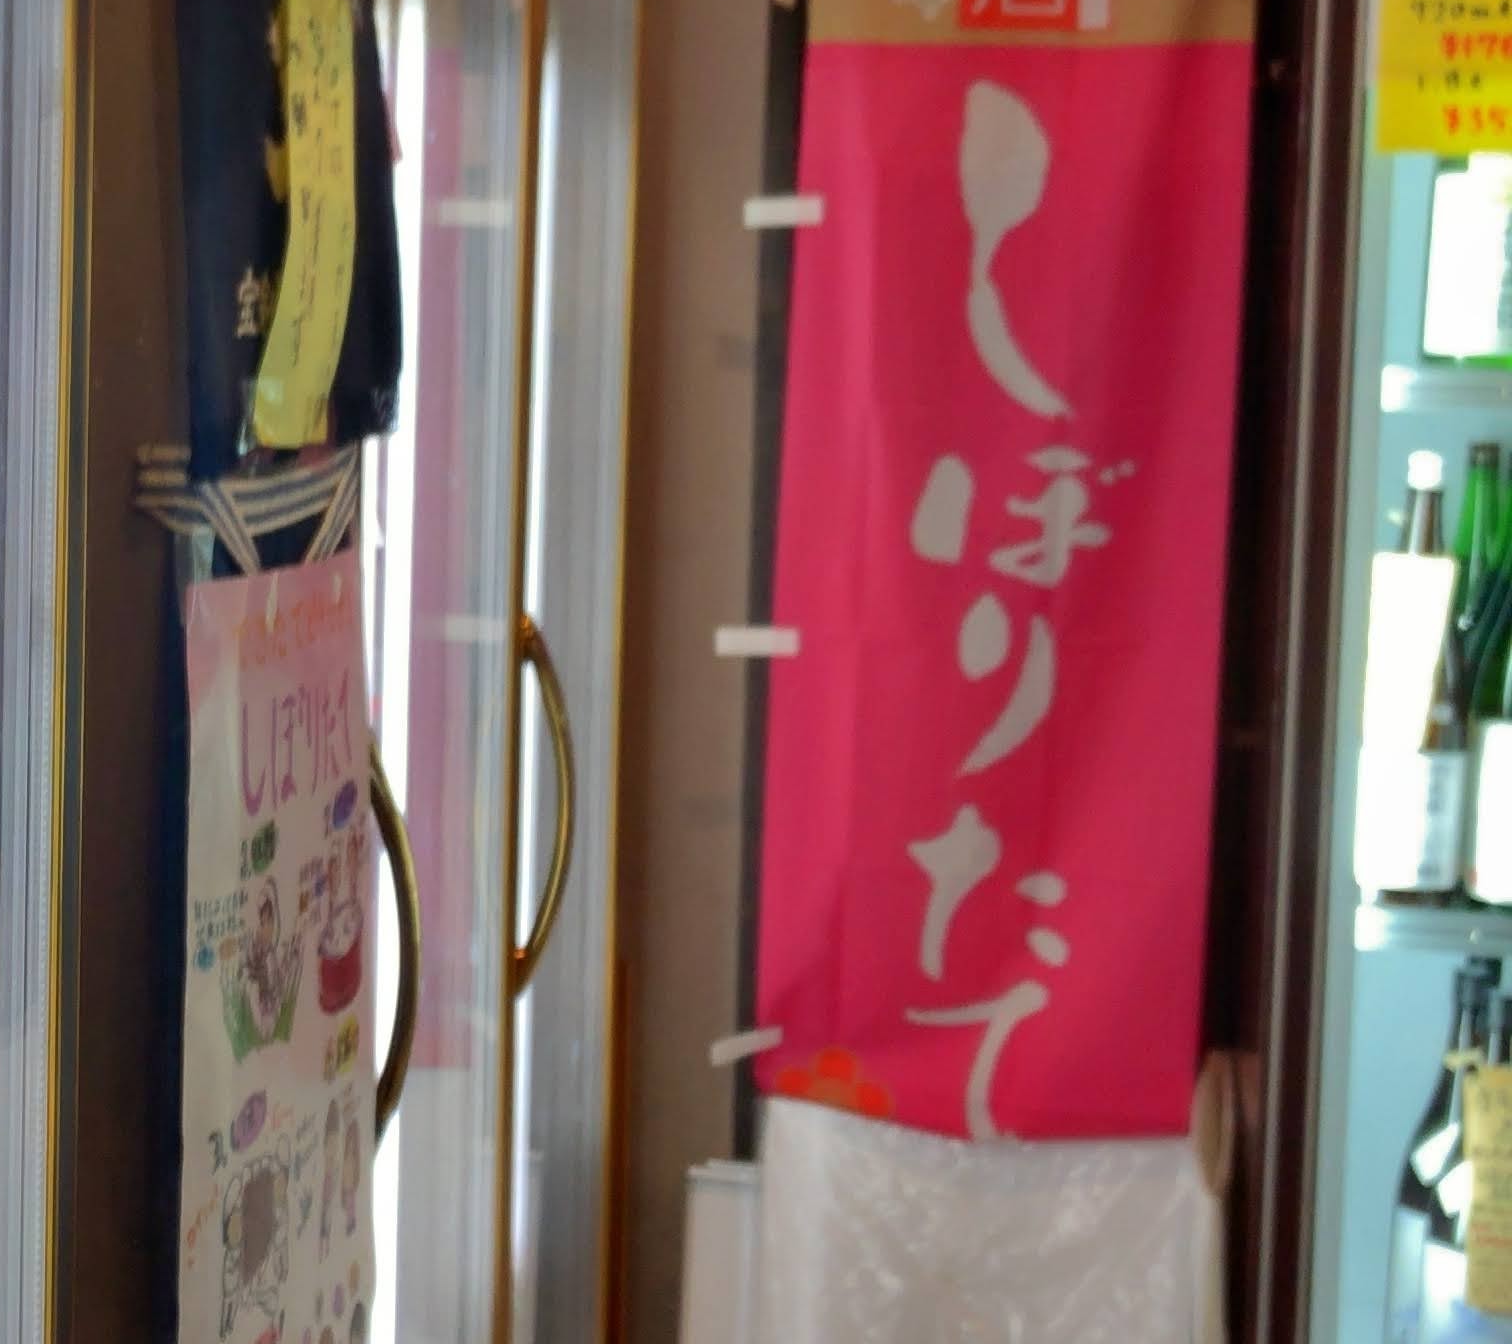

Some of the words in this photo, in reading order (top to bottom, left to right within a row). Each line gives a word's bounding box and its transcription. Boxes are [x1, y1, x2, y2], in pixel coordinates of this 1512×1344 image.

[904, 78, 1136, 1140] しぼりたて
